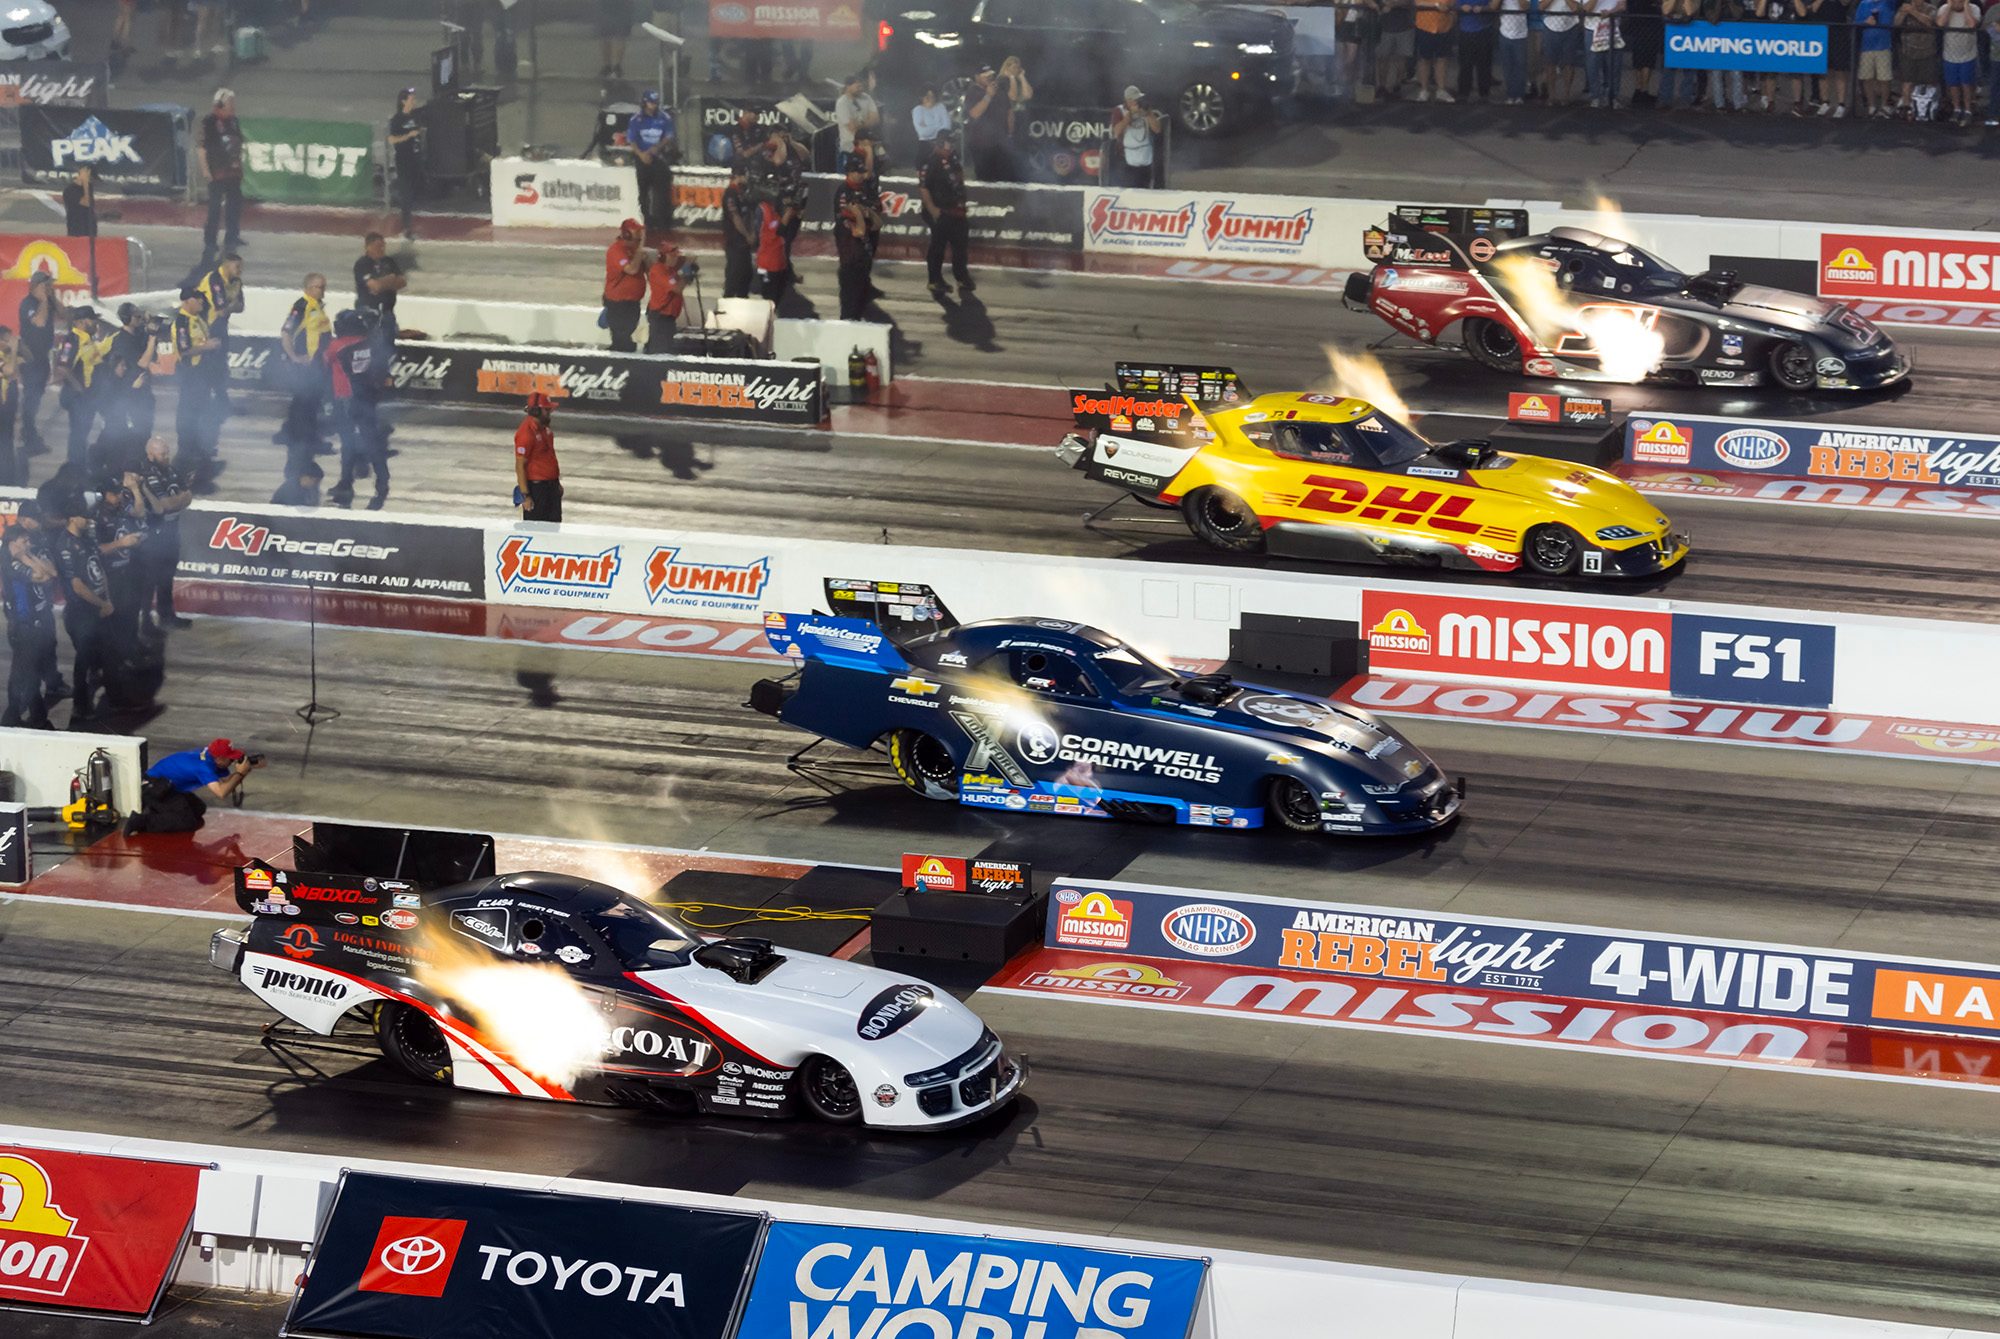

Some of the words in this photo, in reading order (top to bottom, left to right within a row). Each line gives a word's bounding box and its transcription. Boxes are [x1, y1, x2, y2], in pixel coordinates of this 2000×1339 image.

[1669, 35, 1752, 55] CAMPING
[1755, 39, 1823, 57] WORLD
[19, 74, 95, 104] light
[705, 108, 781, 126] FOLW
[51, 134, 143, 168] PEAK
[1090, 197, 1192, 235] SUMMIT
[1206, 203, 1308, 241] SUMMIT
[1394, 248, 1451, 263] McLeod
[1828, 268, 1875, 281] MISSION
[481, 358, 561, 375] AMERICAN
[1700, 370, 1735, 379] DENSO
[557, 364, 630, 399] light
[666, 369, 746, 387] AMERICAN
[660, 380, 756, 408] REBEL
[743, 375, 818, 410] light
[1073, 394, 1184, 419] SealMaster
[1569, 411, 1598, 423] light
[1637, 441, 1687, 456] MISSION
[1728, 437, 1778, 459] NHRA
[1817, 432, 1930, 454] AMERICAN
[1807, 445, 1941, 484] REBEL
[1104, 468, 1159, 488] REVCHEM
[1298, 474, 1484, 535] DHL
[209, 517, 270, 557] K1
[263, 534, 399, 560] RaceGear
[499, 538, 616, 585] SUMMIT
[1466, 549, 1520, 564] DAYCO
[176, 560, 219, 575] ACER'S
[222, 564, 268, 578] BRAND
[271, 566, 288, 578] OF
[291, 569, 340, 583] SAFETY
[342, 573, 378, 585] GEAR
[380, 576, 409, 588] AND
[412, 577, 472, 593] APPAREL
[647, 549, 764, 599] SUMMIT
[513, 586, 551, 596] RACING
[553, 588, 611, 600] EQUIPMENT
[661, 597, 699, 607] RACING
[701, 600, 760, 611] EQUIPMENT
[797, 621, 883, 645] HendrickCars.com
[1371, 634, 1429, 651] MISSION
[1438, 612, 1665, 674] MISSION
[939, 654, 969, 665] PEAK
[1699, 630, 1802, 683] FS1
[888, 695, 940, 709] CHEVROLET
[1061, 734, 1220, 771] CORNWELL
[1058, 748, 1146, 772] QUALITY
[1153, 763, 1222, 784] TOOLS
[962, 793, 1006, 805] HURCO
[971, 867, 1025, 883] REBEL
[974, 861, 1019, 871] AMERICAN
[916, 874, 953, 886] MISSION
[979, 877, 1014, 893] light
[306, 888, 361, 904] BOXO
[1058, 891, 1081, 902] NHRA
[517, 901, 545, 913] HUNTER
[1179, 906, 1242, 919] CHAMPIONSHIP
[464, 916, 497, 937] CGM
[1063, 919, 1124, 937] MISSION
[1178, 914, 1240, 943] NHRA
[1293, 911, 1435, 942] AMERICAN
[333, 931, 373, 948] LOGAN
[1078, 938, 1103, 947] RACING
[1104, 940, 1128, 948] SERIES
[1176, 939, 1200, 952] DRAG
[1203, 943, 1237, 953] RACING
[342, 945, 387, 962] Manufacturing
[388, 953, 405, 965] parts
[1278, 928, 1448, 982] REBEL
[1429, 926, 1566, 984] light
[366, 960, 406, 975] logankc.com
[262, 968, 348, 1000] pronto
[1031, 975, 1184, 998] MISSION
[1485, 974, 1507, 985] EST
[1515, 976, 1540, 987] 1776
[1589, 940, 1855, 1017] 4-WIDE
[270, 988, 288, 997] AUTO
[289, 991, 313, 1003] SERVICE
[313, 995, 337, 1008] CENTER
[1203, 974, 1809, 1060] MISSION
[748, 1067, 789, 1080] MONROE
[752, 1082, 784, 1091] MOOG
[746, 1099, 779, 1109] WAGNER
[478, 1244, 686, 1307] TOYOTA
[795, 1242, 1154, 1328] CAMPING
